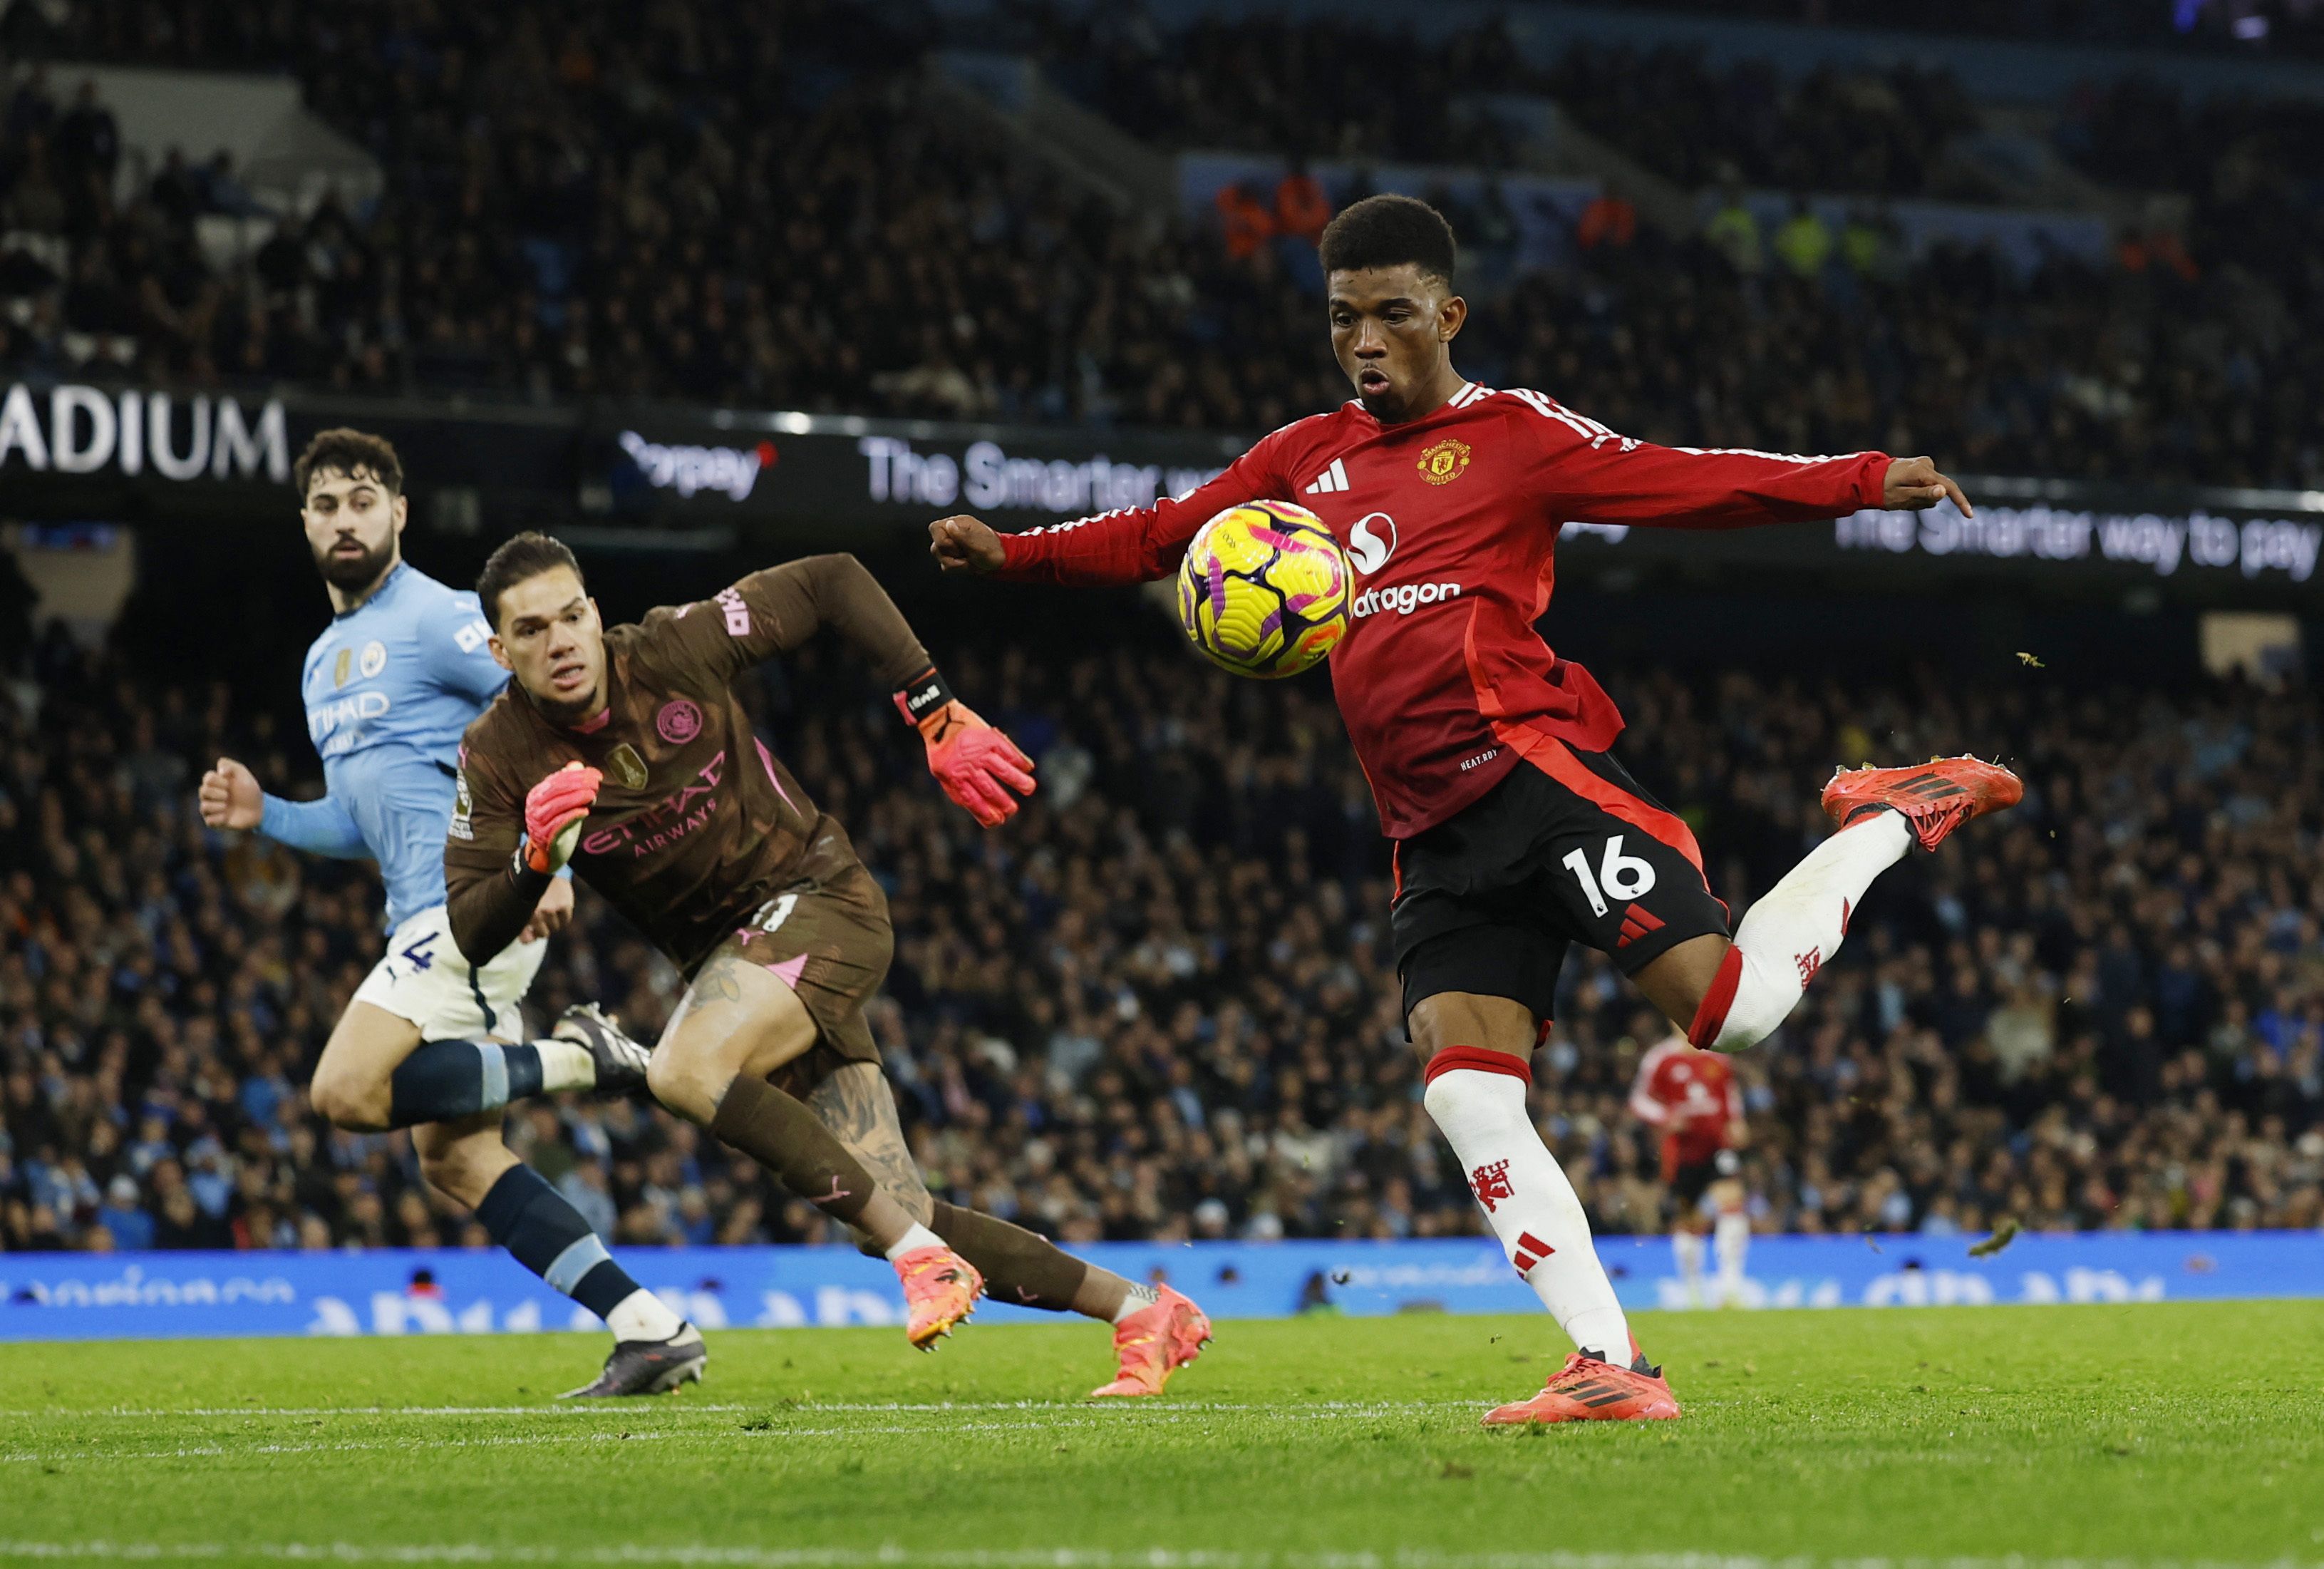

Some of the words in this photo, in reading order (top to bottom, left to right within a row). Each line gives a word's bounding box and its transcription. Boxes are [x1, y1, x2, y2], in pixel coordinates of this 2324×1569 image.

[857, 436, 959, 507] The
[964, 441, 1163, 513] Smarter
[1426, 471, 1456, 483] UNITED
[2095, 513, 2188, 576] way
[2189, 510, 2239, 567] to
[2241, 518, 2322, 582] pay
[1353, 582, 1461, 618] dragon
[1460, 749, 1497, 771] HEAT.RDY
[1562, 835, 1656, 918] 16
[401, 931, 440, 974] 4
